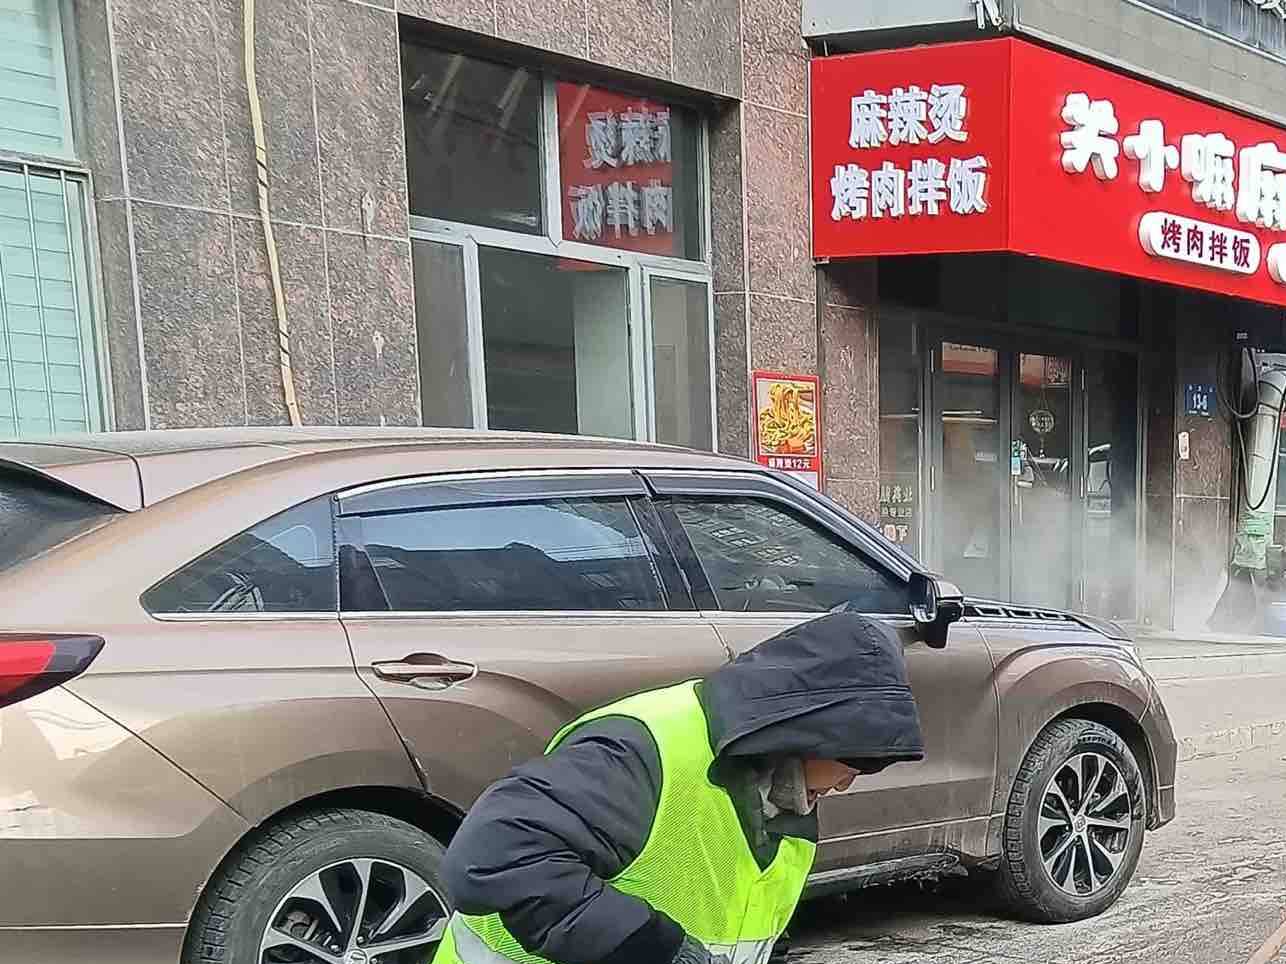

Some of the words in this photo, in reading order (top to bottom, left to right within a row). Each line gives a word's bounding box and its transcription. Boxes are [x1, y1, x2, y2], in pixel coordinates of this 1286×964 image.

[849, 84, 968, 149] 麻辣烫
[830, 155, 989, 222] 烤肉拌饭
[1160, 218, 1251, 270] 烤肉拌饭
